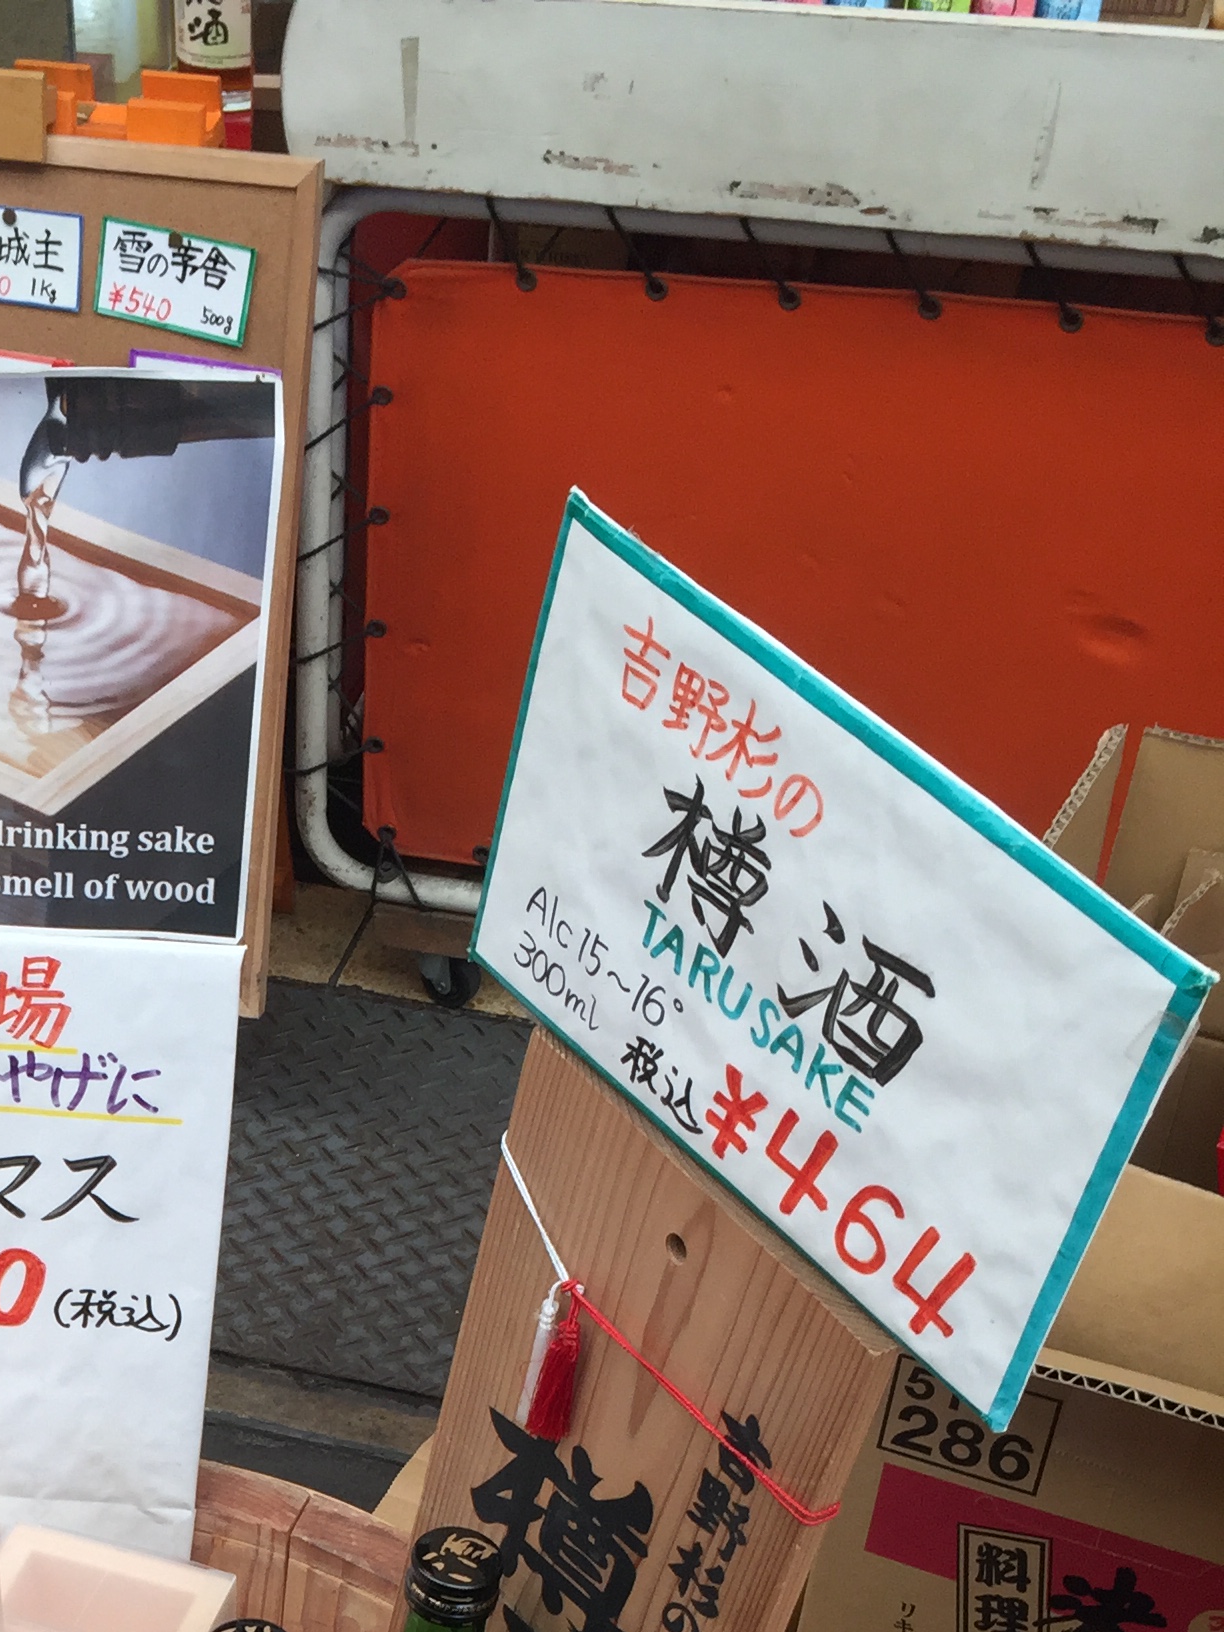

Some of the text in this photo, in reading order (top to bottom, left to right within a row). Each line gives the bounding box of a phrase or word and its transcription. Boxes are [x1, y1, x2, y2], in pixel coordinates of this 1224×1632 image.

[108, 281, 234, 335] ¥540 500g
[622, 616, 824, 839] 吉野杉の
[136, 825, 216, 856] sake
[84, 873, 120, 902] of
[123, 876, 216, 906] wood
[641, 774, 936, 1087] 樽酒
[512, 930, 601, 1034] 300ml
[619, 1034, 977, 1340] 税込 ¥464
[890, 1404, 1039, 1483] 286
